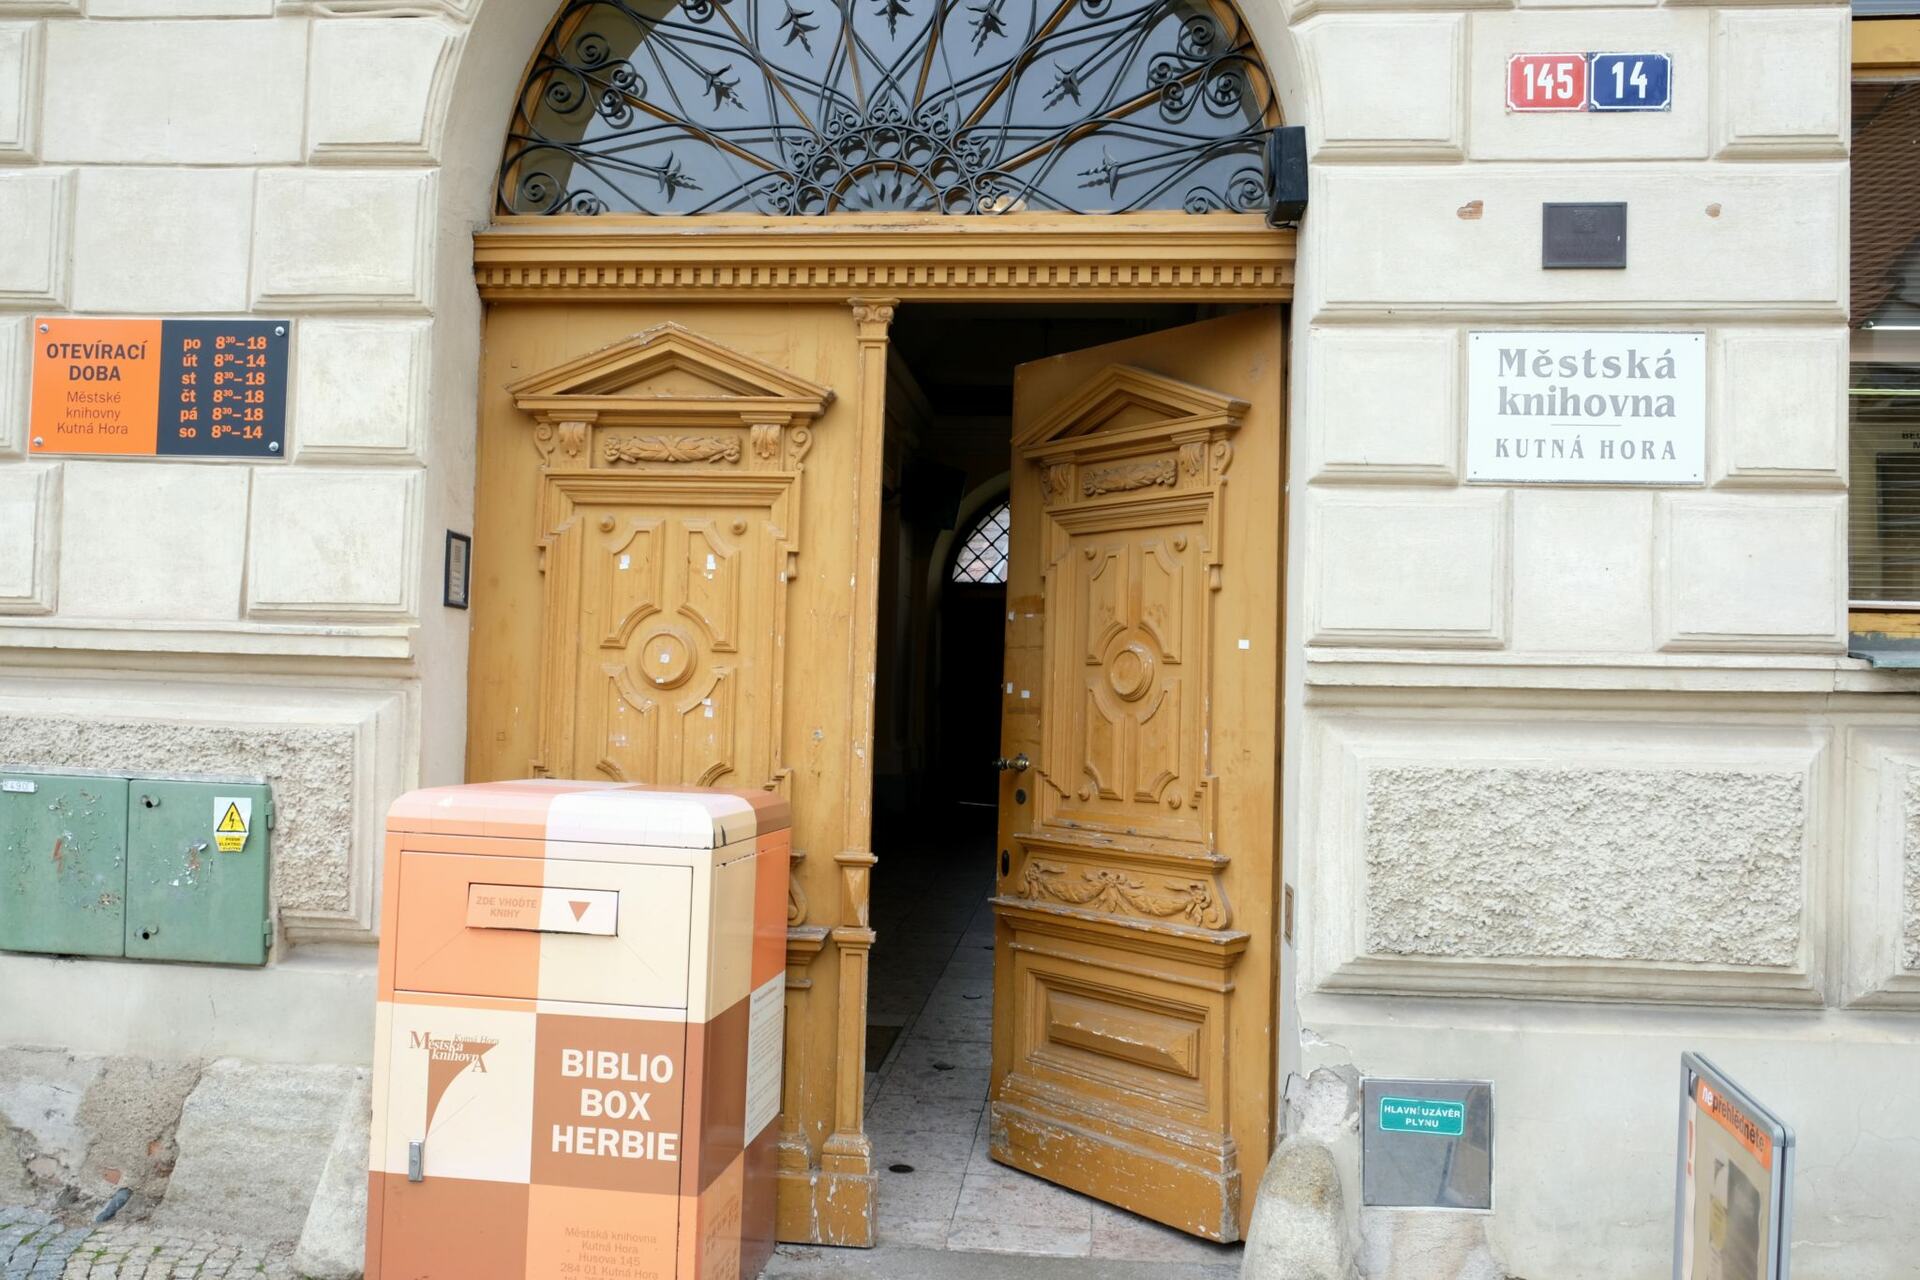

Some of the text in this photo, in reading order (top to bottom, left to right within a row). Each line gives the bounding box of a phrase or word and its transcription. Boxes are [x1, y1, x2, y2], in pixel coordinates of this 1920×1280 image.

[1523, 63, 1574, 100] 145
[1612, 61, 1648, 99] 14
[46, 339, 148, 360] OTEVÍRACÍ
[183, 338, 202, 352] po
[182, 354, 198, 367] út
[1498, 348, 1676, 379] Městská
[69, 365, 121, 381] DOBA
[181, 372, 197, 385] st
[67, 391, 121, 404] Městské
[181, 389, 197, 403] čt
[1498, 385, 1676, 418] knihovna
[66, 407, 121, 421] knihovny
[180, 407, 198, 423] pá
[57, 422, 129, 435] Kutná Hora
[179, 427, 197, 439] so
[1495, 435, 1677, 460] KUTNÁ HORA
[476, 896, 496, 906] ZDE
[489, 908, 520, 918] KNIHY
[561, 1048, 674, 1084] BIBLIO
[580, 1088, 651, 1121] BOX
[1384, 1105, 1421, 1115] HLAVNÍ
[1405, 1118, 1439, 1128] PLYNU
[551, 1124, 679, 1162] HERBIE
[611, 1231, 657, 1244] knihovna
[582, 1240, 639, 1254] Kutná Hora
[579, 1252, 641, 1267] Husova 145
[560, 1262, 580, 1273] 284
[584, 1264, 597, 1275] 01
[601, 1265, 631, 1278] Kutná
[634, 1268, 659, 1280] Hora
